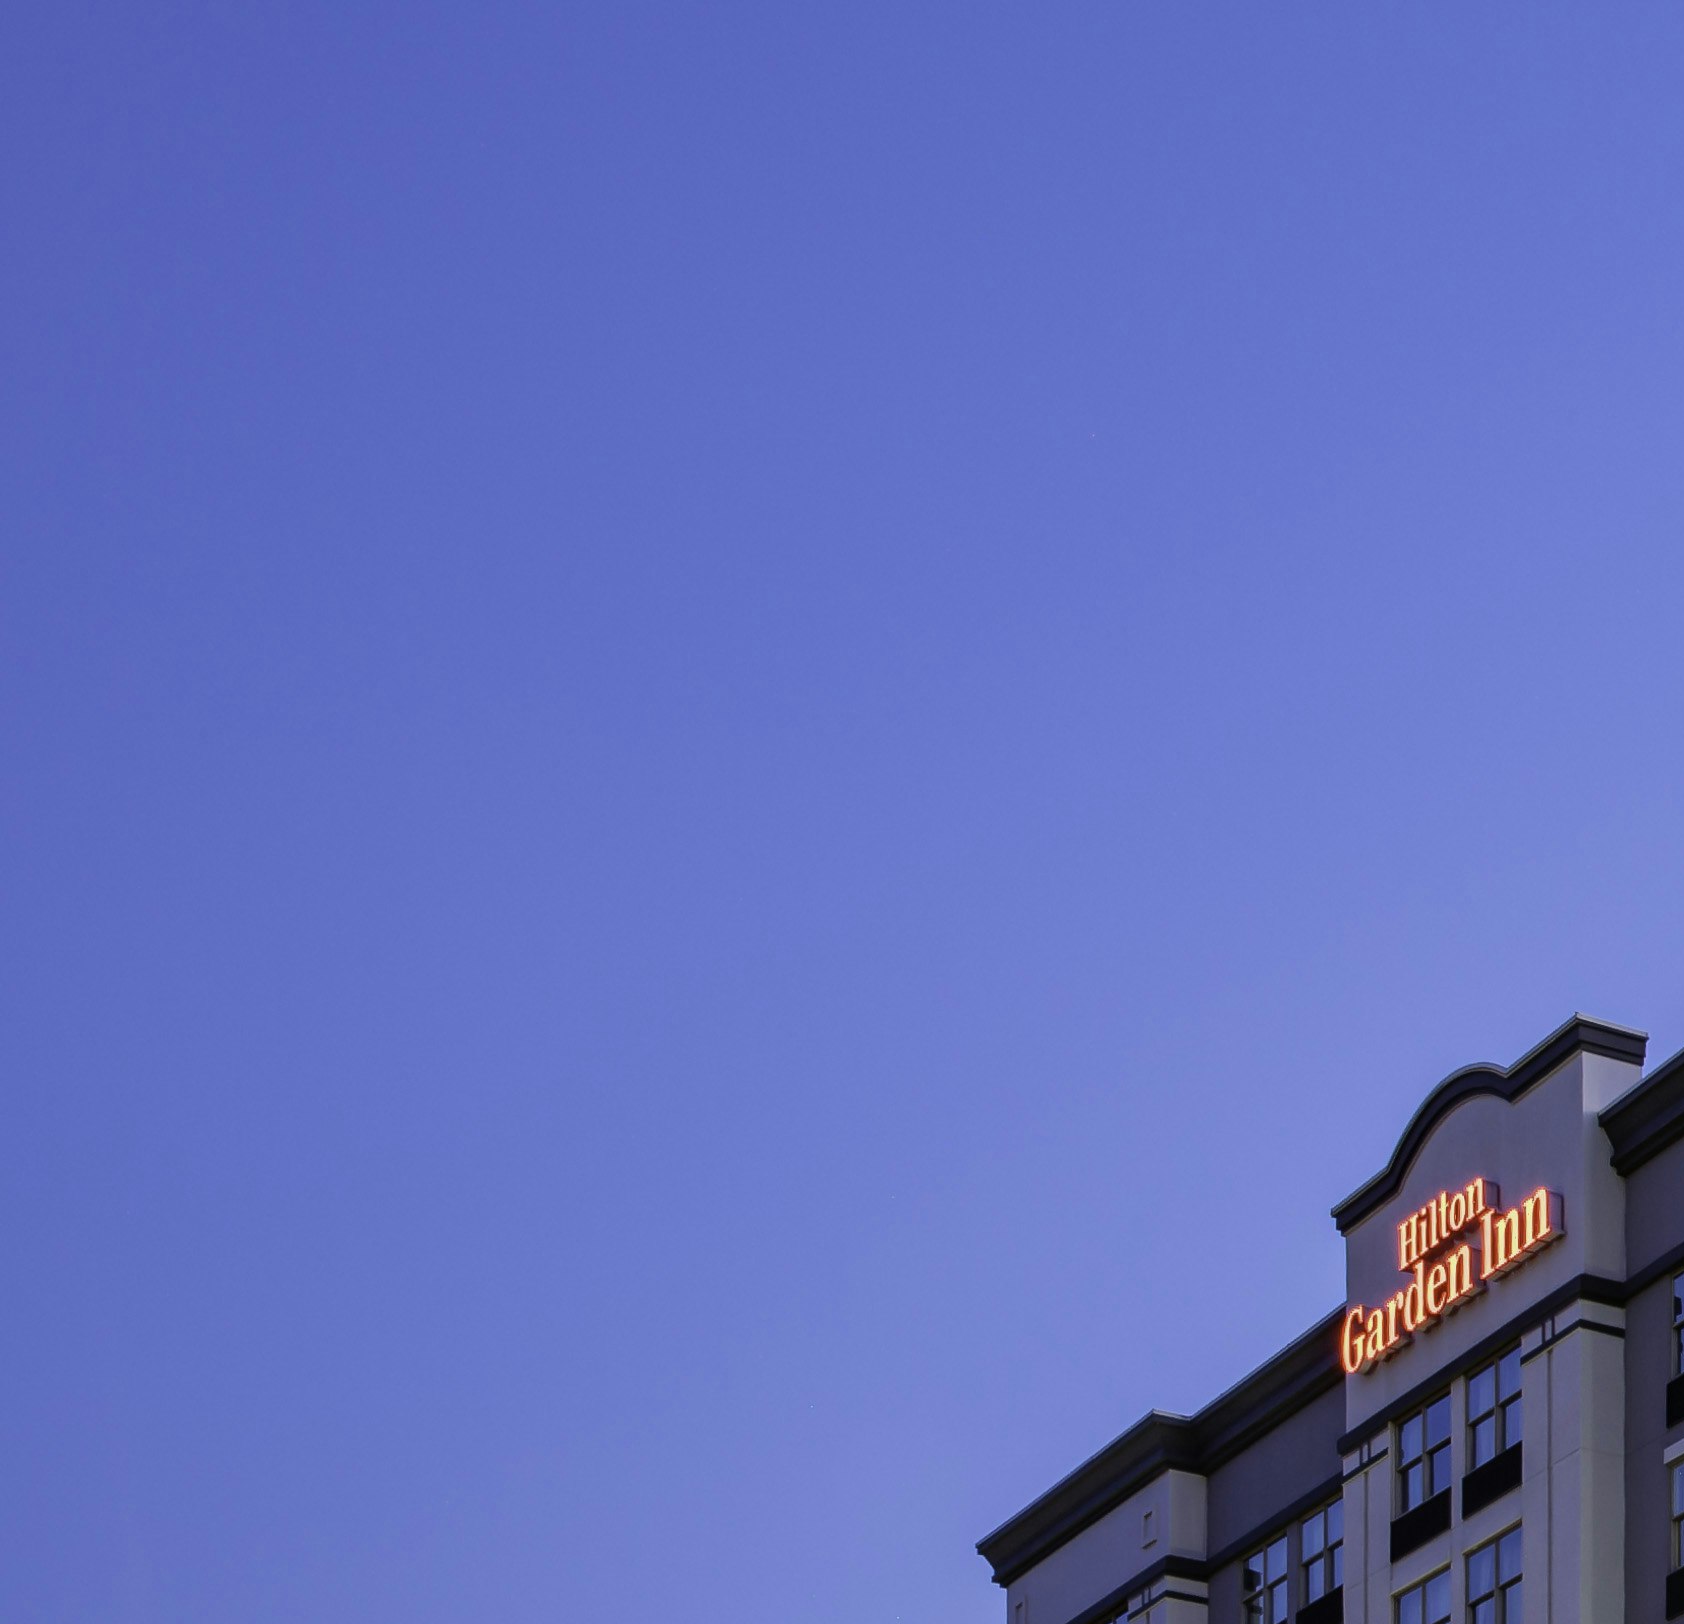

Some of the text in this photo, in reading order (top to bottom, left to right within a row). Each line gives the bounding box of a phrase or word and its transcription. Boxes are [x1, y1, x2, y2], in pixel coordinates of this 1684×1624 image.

[1341, 1187, 1553, 1373] Garden Inn
[1398, 1177, 1486, 1271] Hilton
